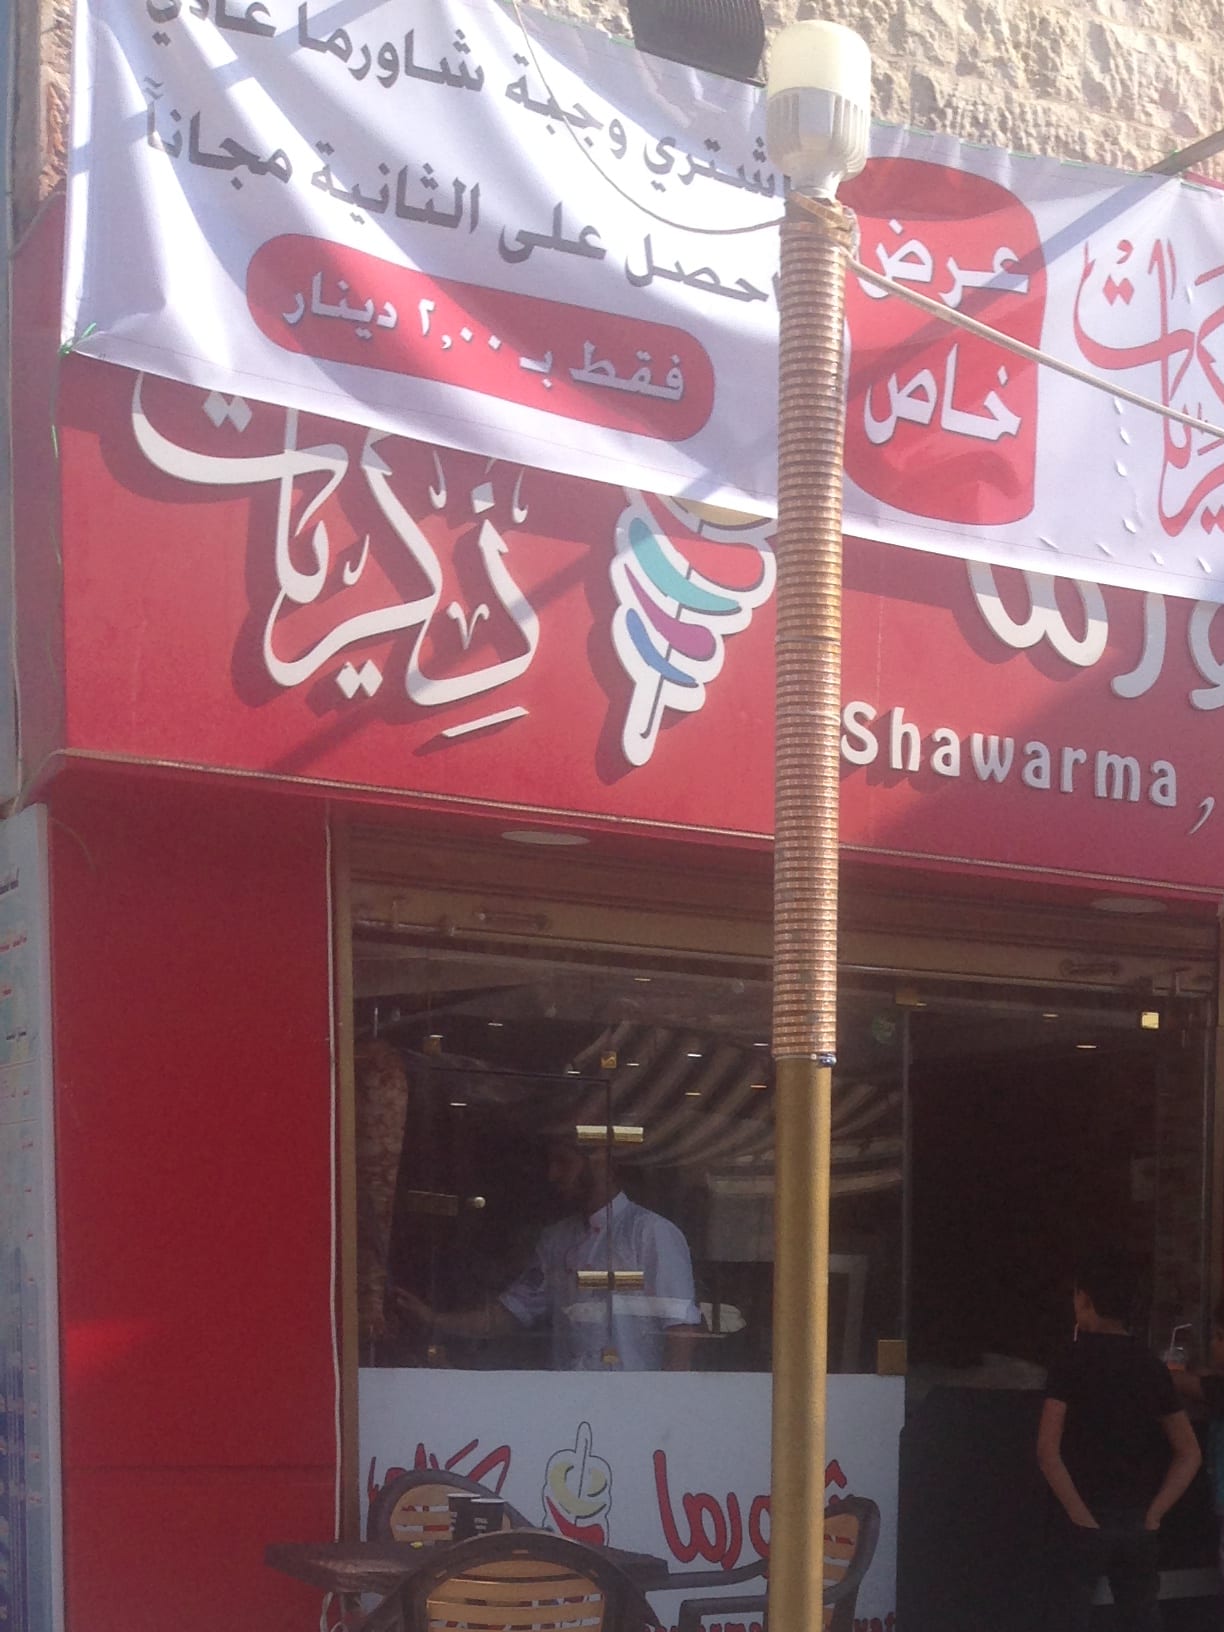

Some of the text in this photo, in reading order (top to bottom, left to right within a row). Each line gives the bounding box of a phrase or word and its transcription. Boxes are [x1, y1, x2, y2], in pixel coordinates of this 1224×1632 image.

[299, 1, 485, 92] شاورما
[505, 53, 628, 159] وجبة
[311, 140, 480, 233] الثانية
[498, 201, 607, 264] على
[857, 218, 1029, 308] عرض
[282, 271, 397, 340] دينار
[569, 340, 684, 401] فقط
[864, 343, 1022, 444] خاص
[841, 701, 1177, 807] Shawarma
